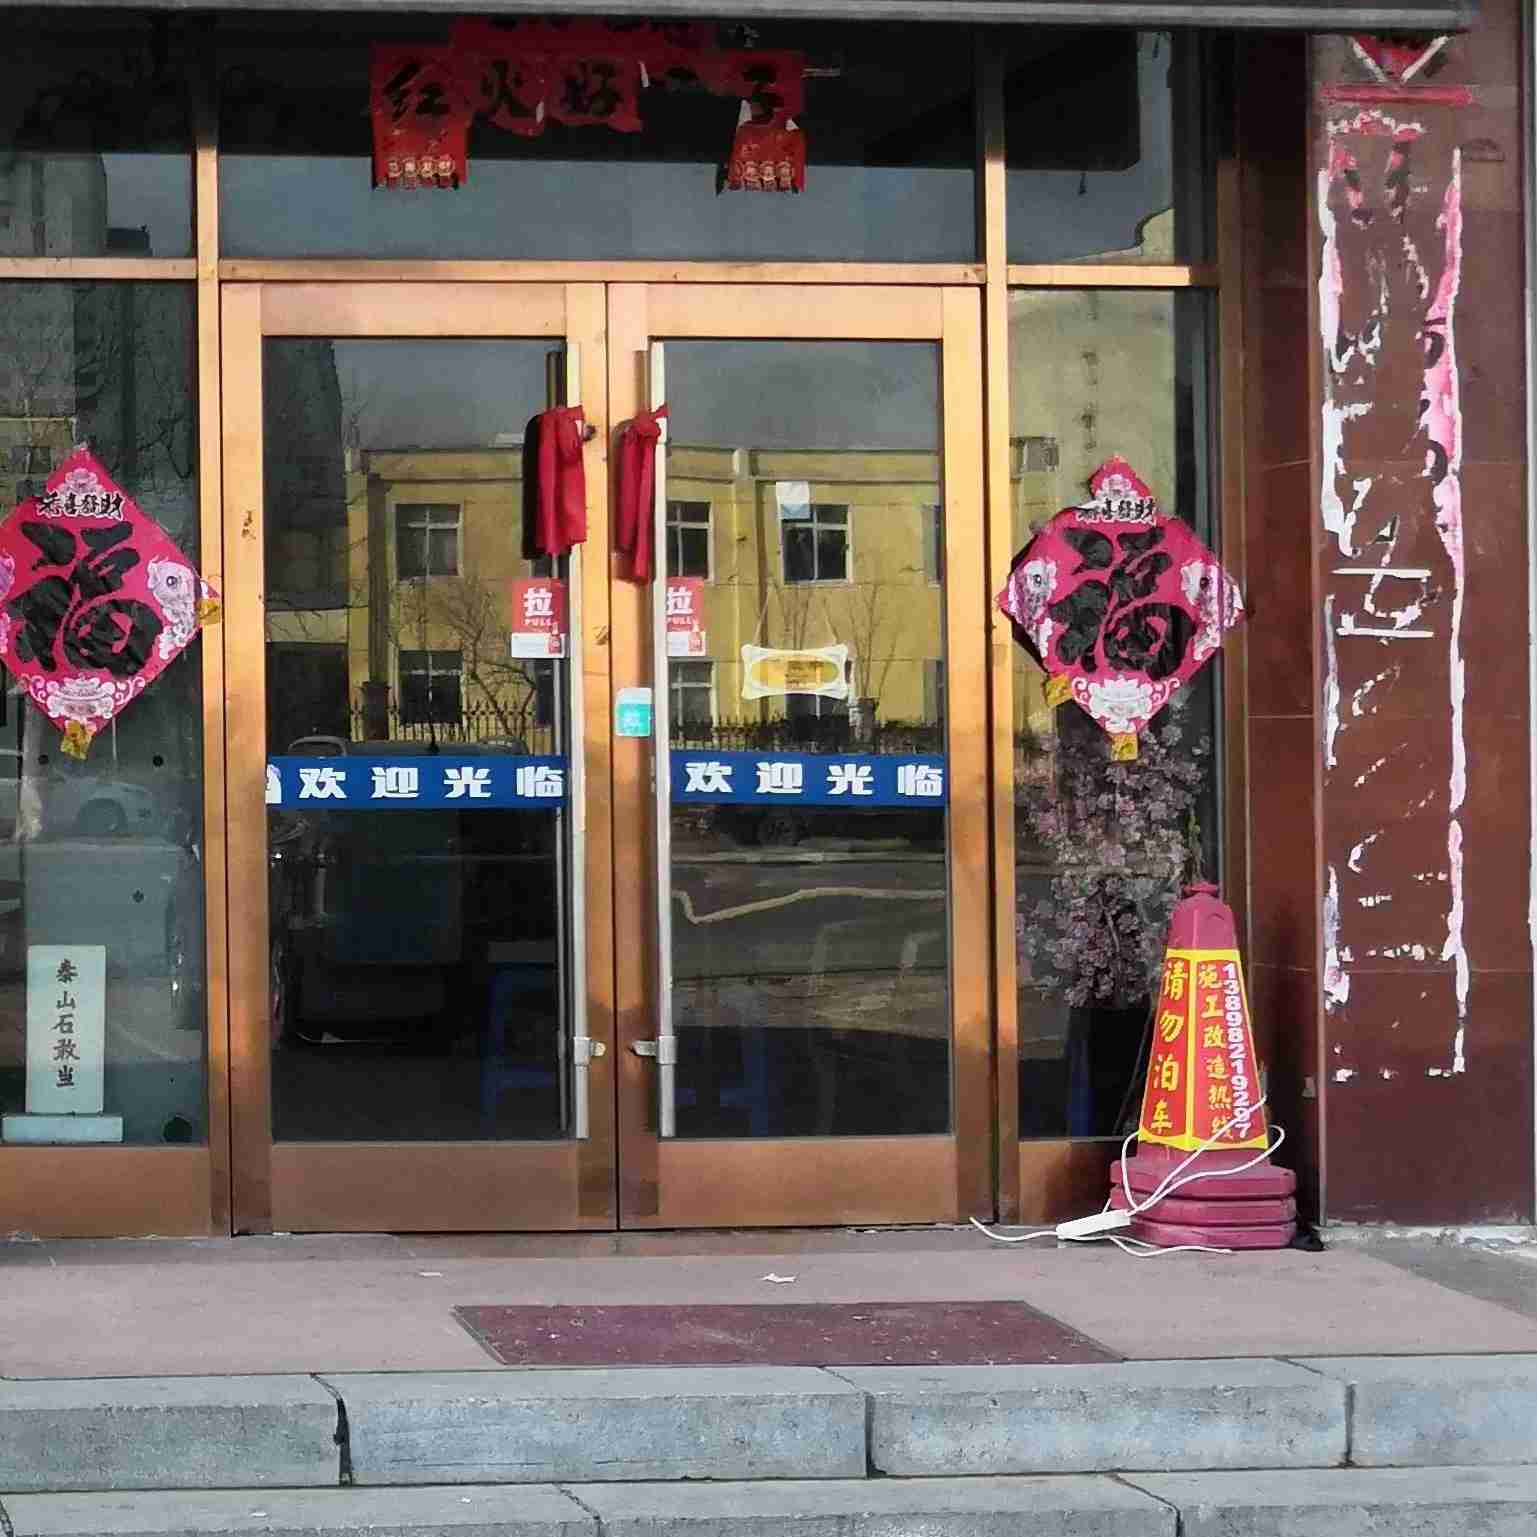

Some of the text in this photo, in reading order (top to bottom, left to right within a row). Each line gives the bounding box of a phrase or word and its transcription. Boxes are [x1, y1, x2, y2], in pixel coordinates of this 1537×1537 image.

[7, 520, 163, 677] 福
[523, 588, 553, 617] 拉
[667, 586, 694, 616] 拉
[1048, 526, 1198, 679] 福
[524, 618, 552, 626] PULL
[299, 766, 566, 800] 欢迎光临
[685, 762, 944, 798] 欢迎光临
[52, 958, 80, 1088] 泰山石敢当
[1151, 961, 1188, 1134] 请勿泊车
